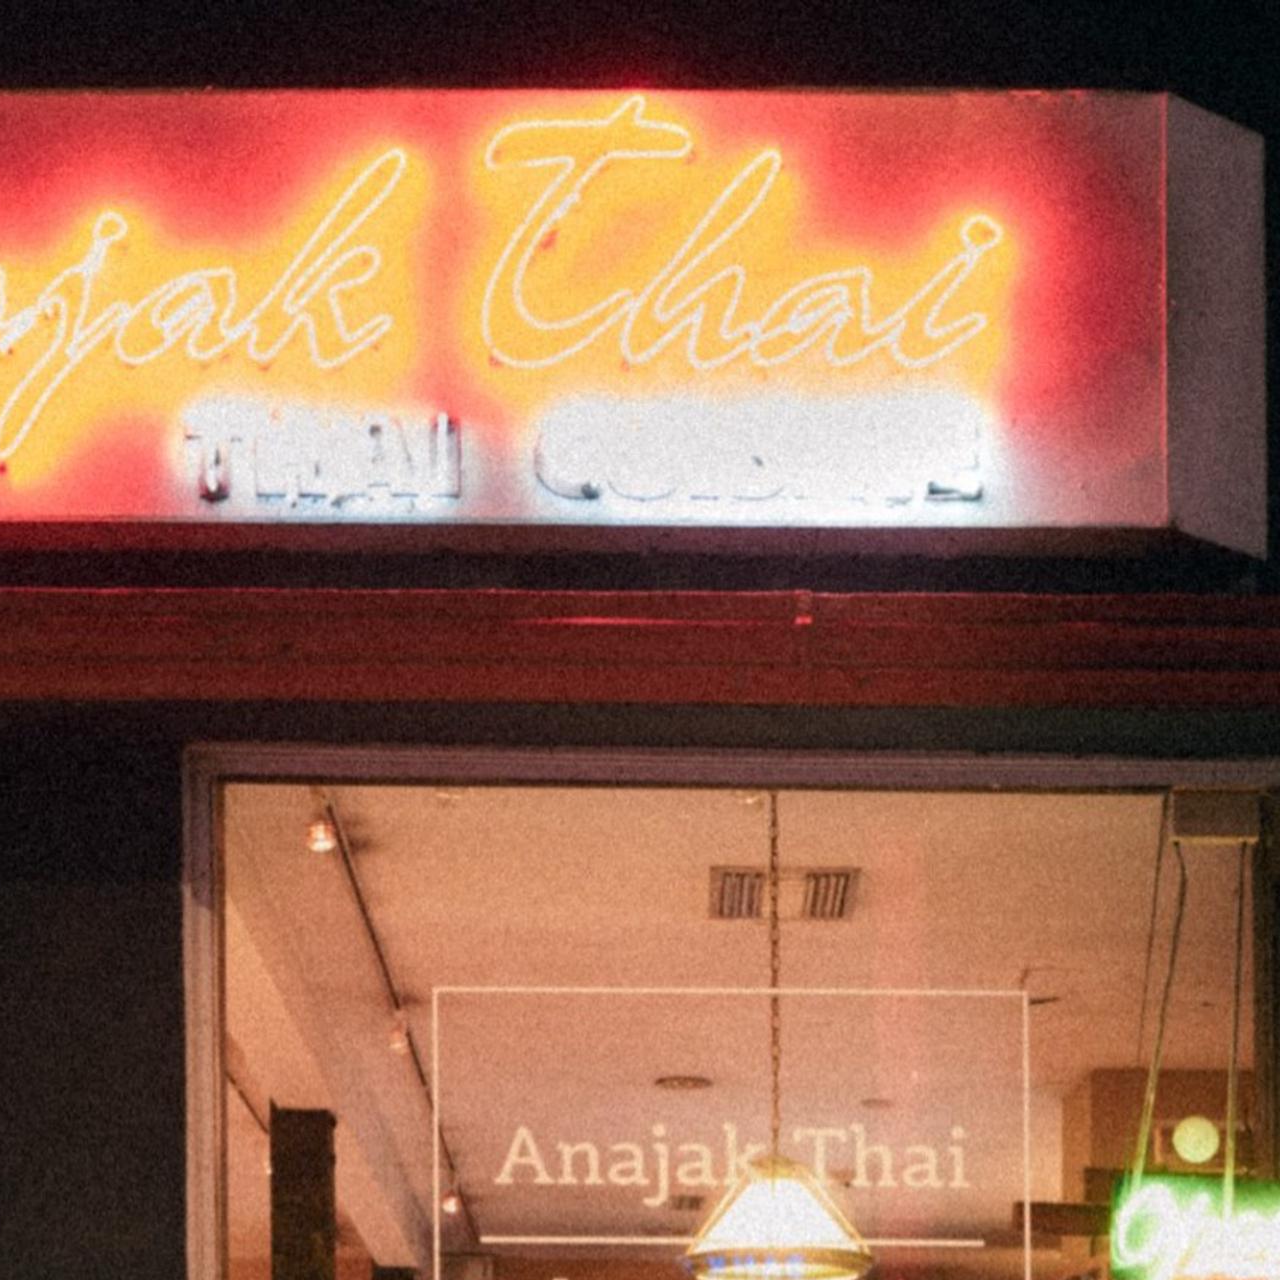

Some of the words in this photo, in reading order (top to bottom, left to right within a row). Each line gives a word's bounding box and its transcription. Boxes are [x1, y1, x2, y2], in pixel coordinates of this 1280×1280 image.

[478, 94, 1006, 376] Thai
[532, 408, 986, 504] CUISE
[493, 1123, 766, 1207] Anajak
[792, 1123, 970, 1188] Thai
